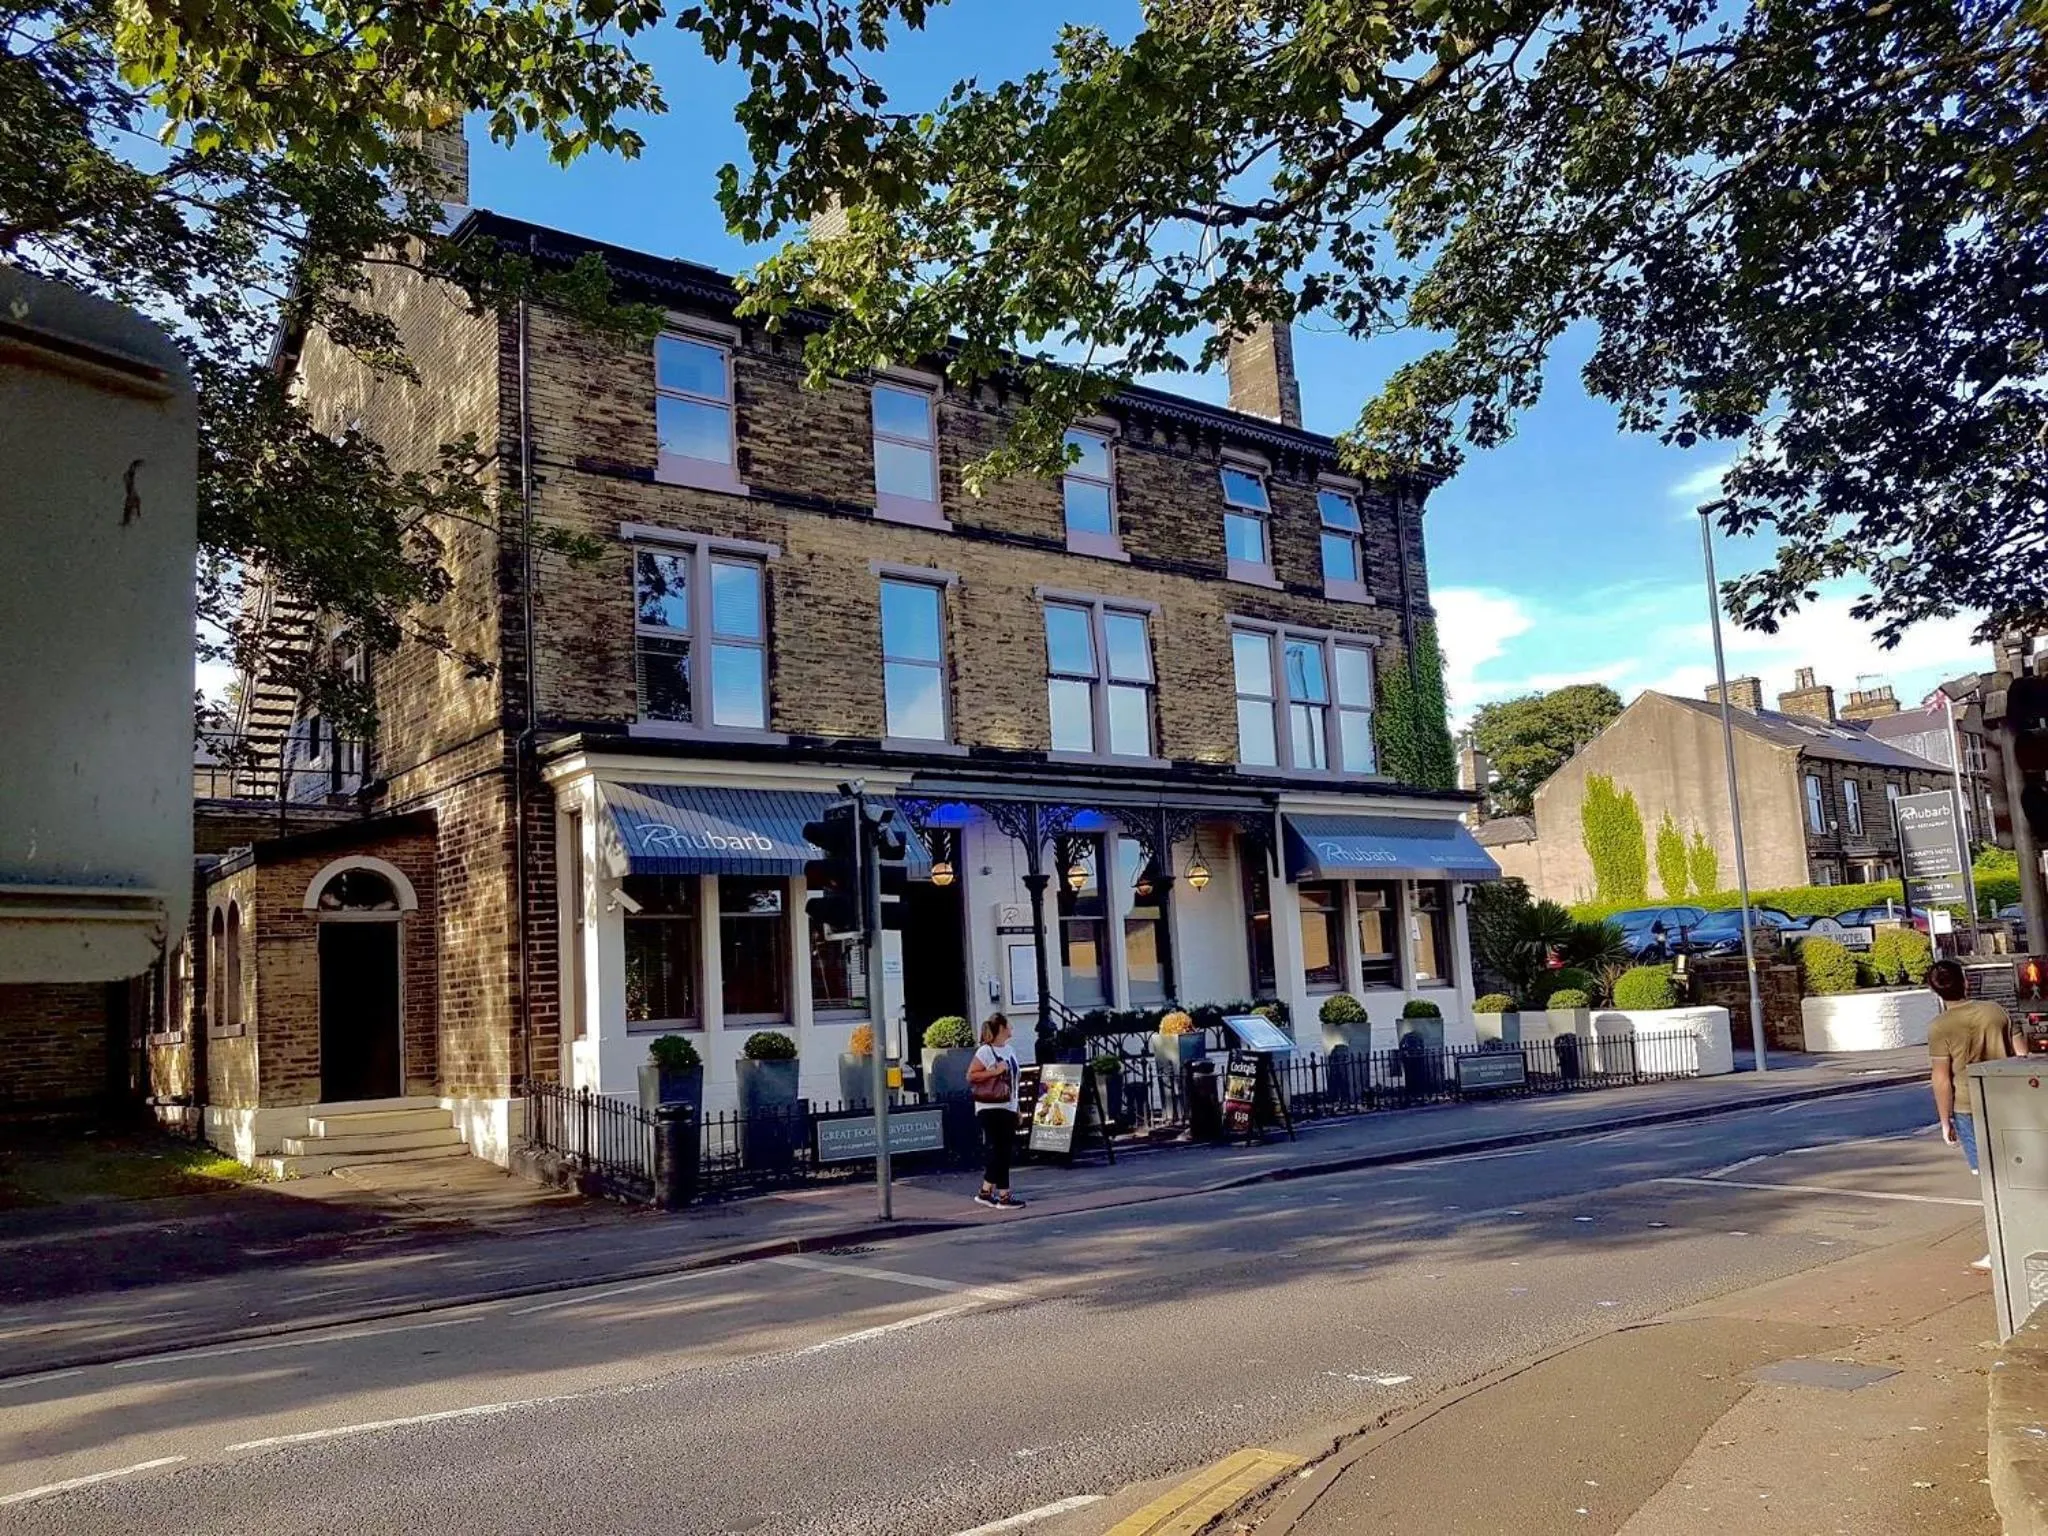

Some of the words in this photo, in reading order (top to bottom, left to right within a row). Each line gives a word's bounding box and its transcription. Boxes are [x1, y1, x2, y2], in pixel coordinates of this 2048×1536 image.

[1899, 805, 1951, 821] Rhubarb
[635, 823, 773, 851] Rhubarb
[1318, 841, 1397, 862] Rhubarb
[1835, 933, 1866, 943] HOTEL
[822, 1129, 851, 1142] GREAT
